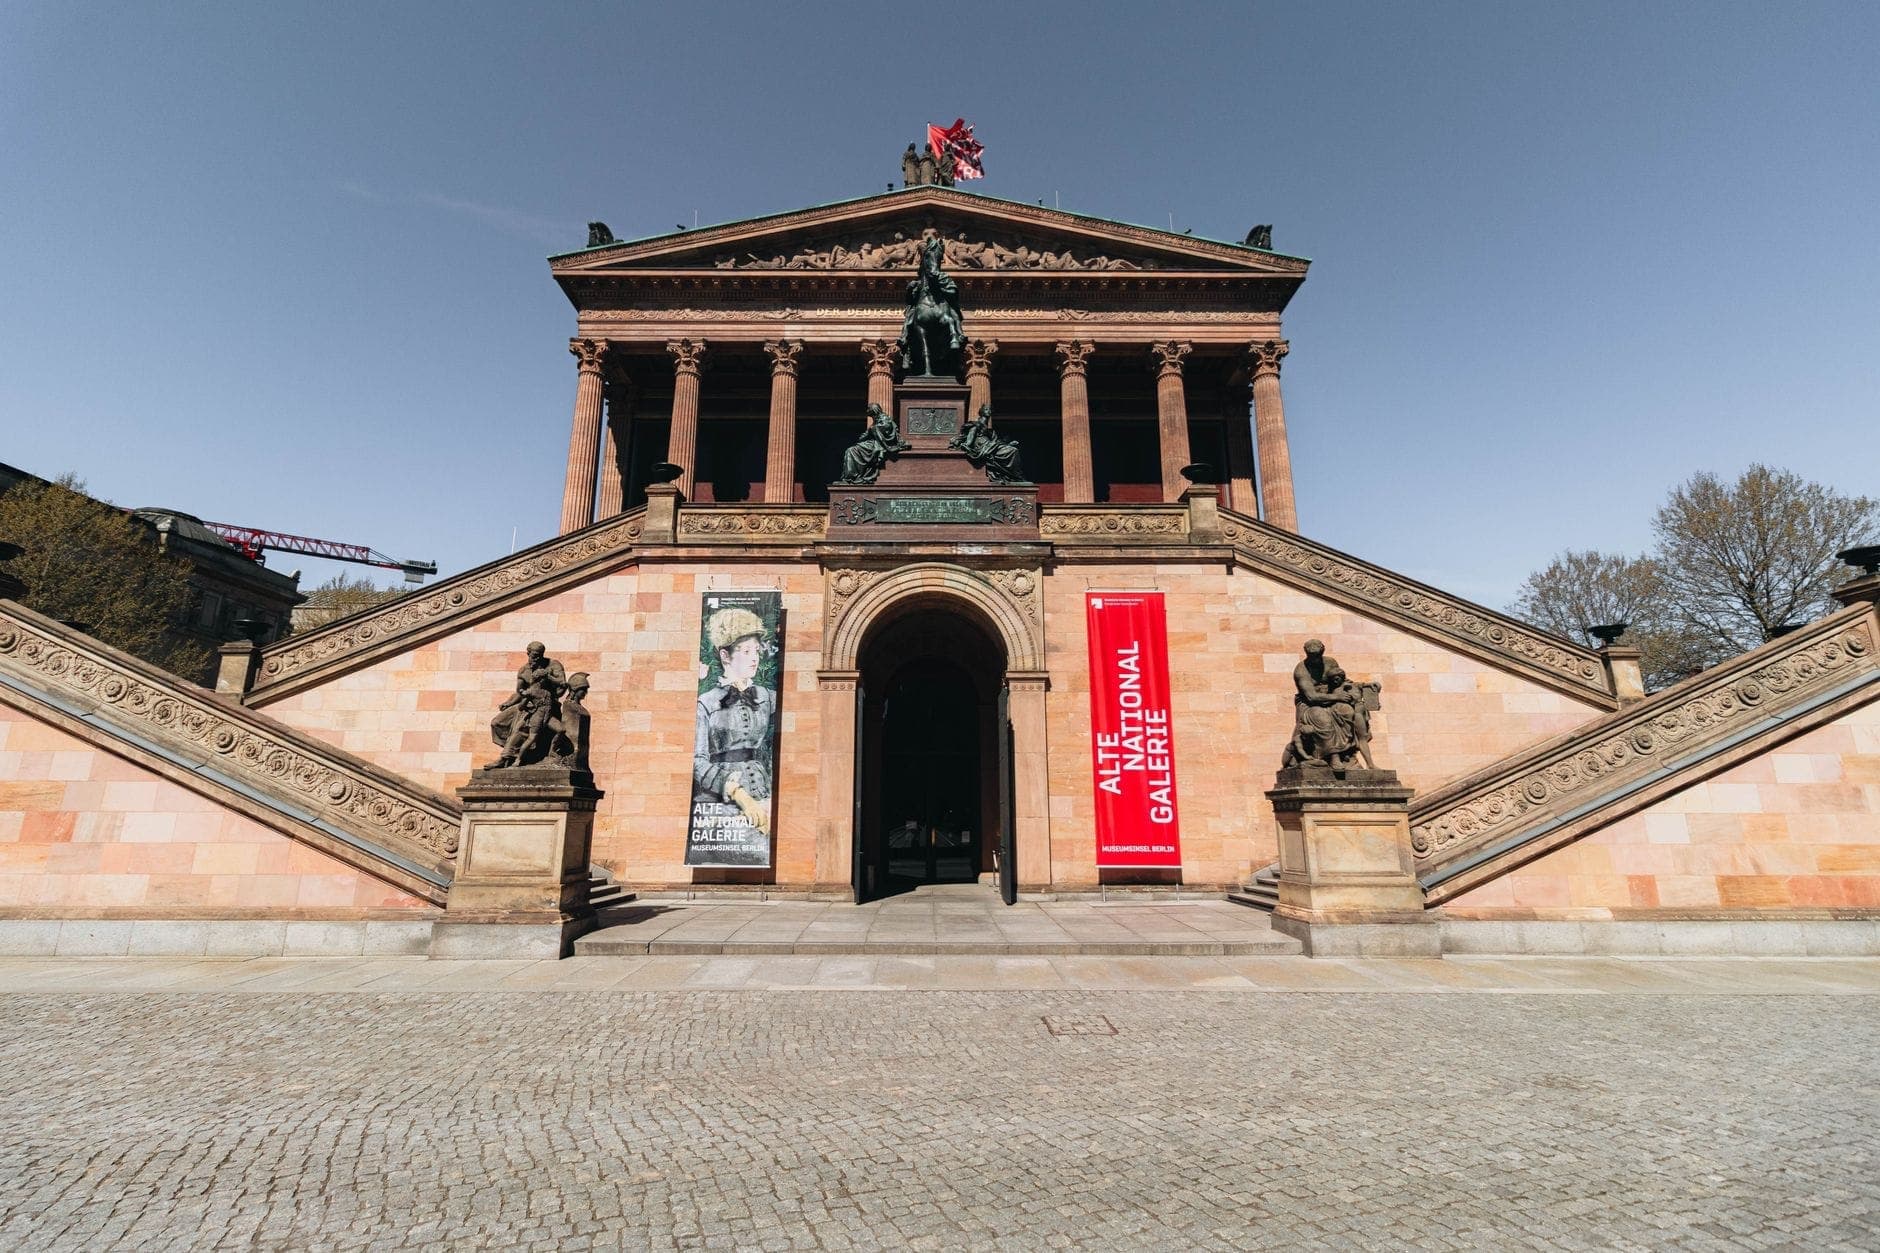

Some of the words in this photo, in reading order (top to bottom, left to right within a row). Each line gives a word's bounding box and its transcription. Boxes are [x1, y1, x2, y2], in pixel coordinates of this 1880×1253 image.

[817, 307, 840, 316] DER
[847, 307, 905, 316] DEUTSCH
[1118, 641, 1144, 771] NATIONAL
[1097, 732, 1121, 794] ALTE
[1145, 709, 1173, 823] GALERIE
[693, 803, 723, 814] ALTE
[693, 816, 755, 827] NATIONAL
[692, 829, 746, 841] GALERIE
[691, 844, 740, 852] MUSEUMSINSEL
[1102, 845, 1151, 853] MUSEUMSINSEL
